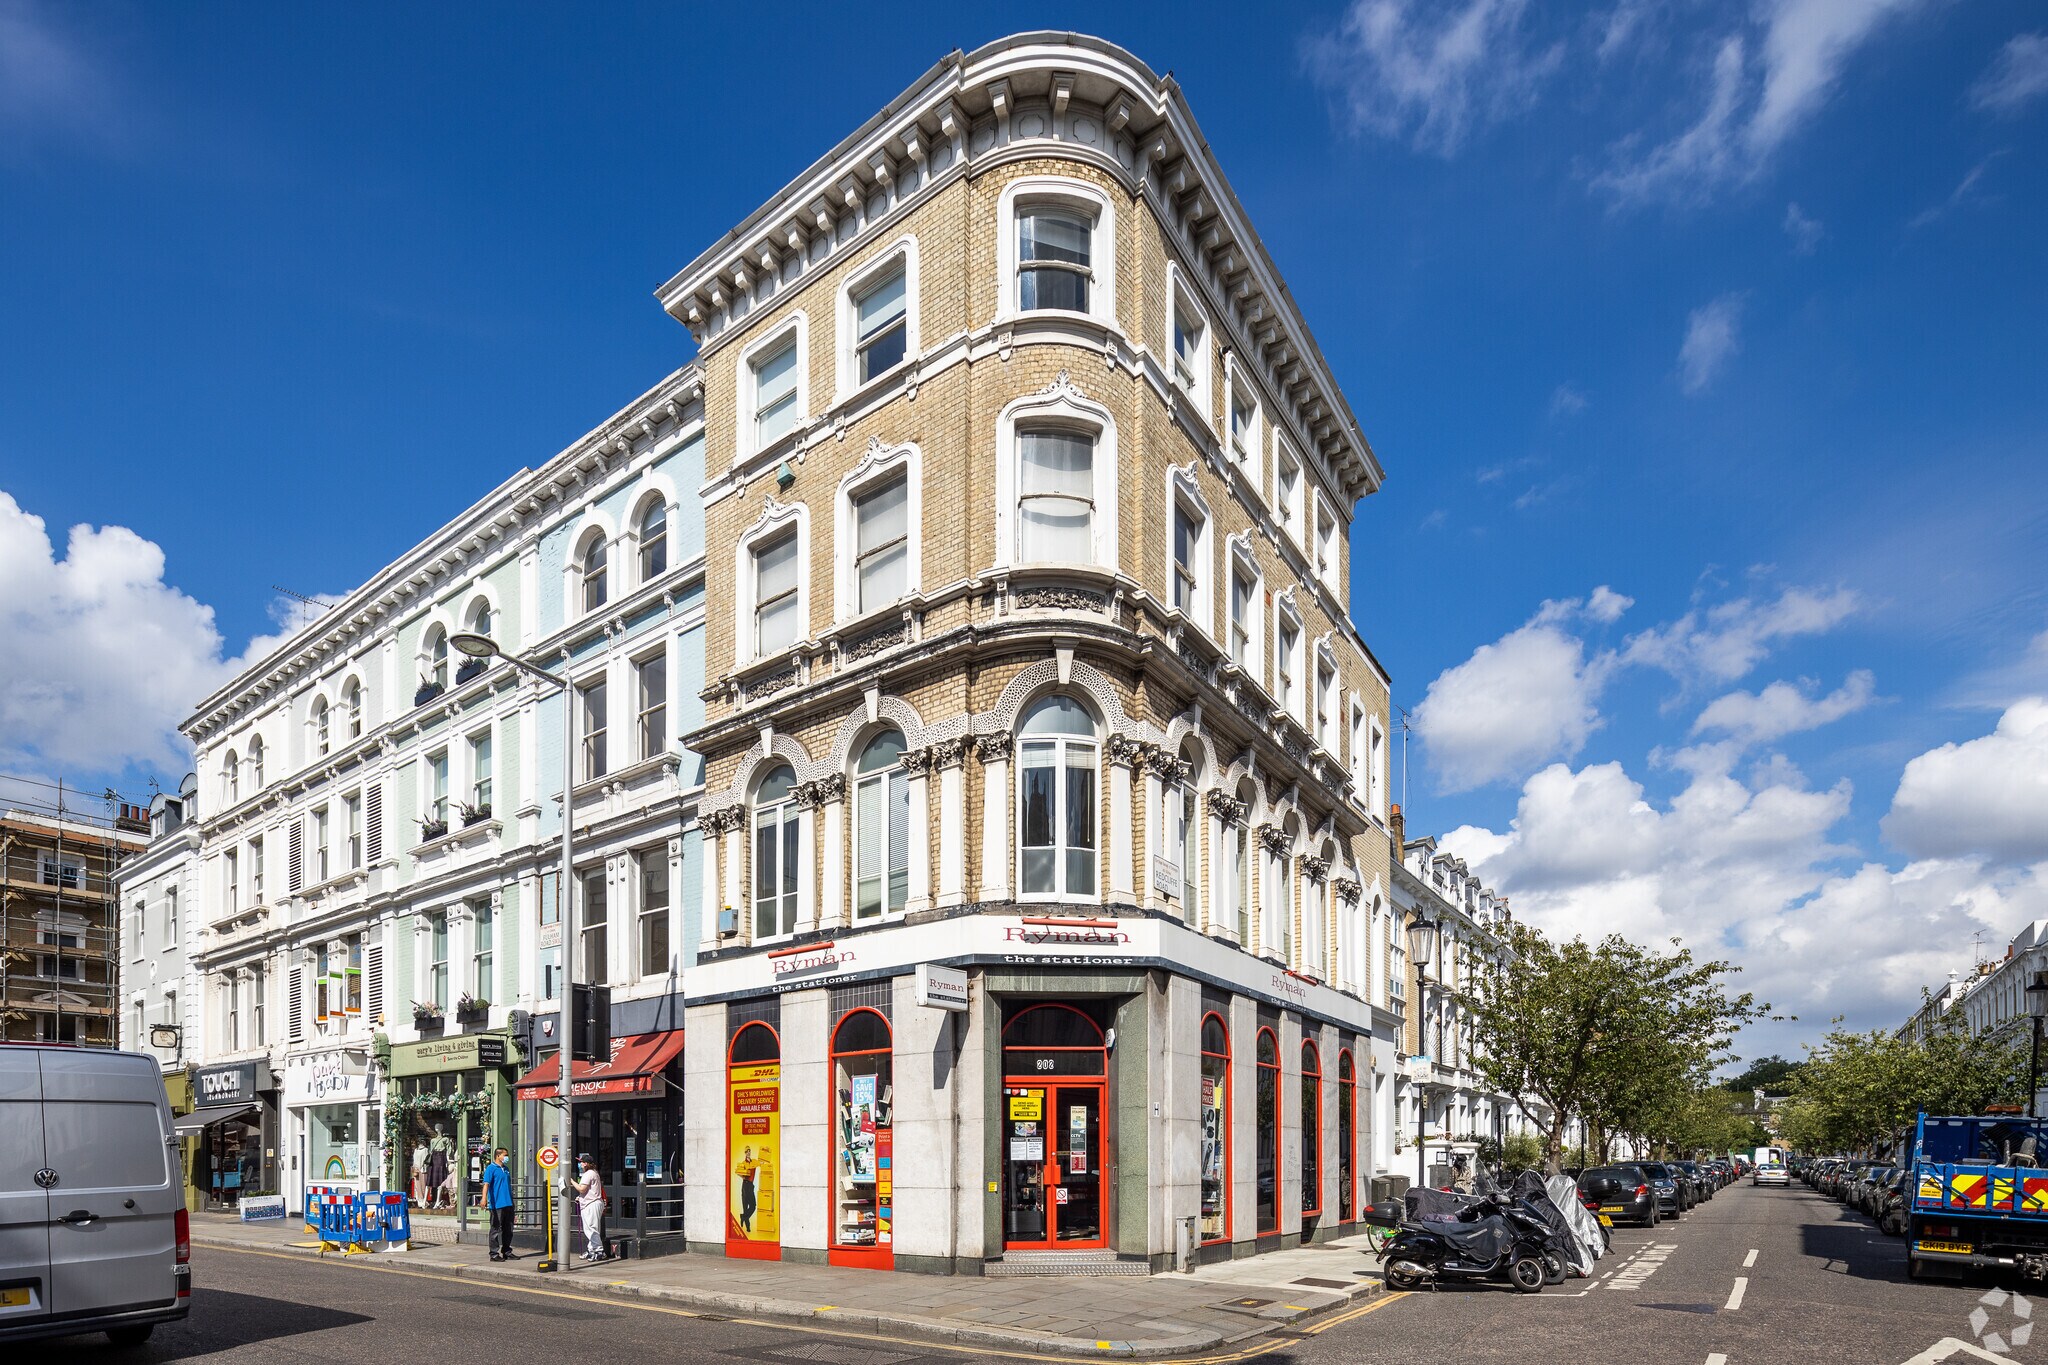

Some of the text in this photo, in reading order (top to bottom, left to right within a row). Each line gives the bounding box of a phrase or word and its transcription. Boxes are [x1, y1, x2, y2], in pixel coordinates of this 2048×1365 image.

[1156, 870, 1178, 888] REDCLIFFE
[1156, 880, 1168, 892] ROAD
[1003, 927, 1132, 944] Ryman
[772, 950, 857, 974] Ryman
[1004, 955, 1133, 965] the stationer
[772, 974, 858, 993] the stationer
[929, 978, 965, 992] Ryman
[1271, 975, 1307, 997] Ryman
[1036, 1059, 1055, 1070] 202
[753, 1069, 775, 1077] DHL
[202, 1070, 239, 1094] TOUCH
[855, 1083, 873, 1092] SAVE
[749, 1089, 775, 1097] WORLDWIDE
[855, 1091, 873, 1103] 15%
[740, 1104, 760, 1112] AVAILABLE
[1922, 1241, 1968, 1252] GK19 BYR
